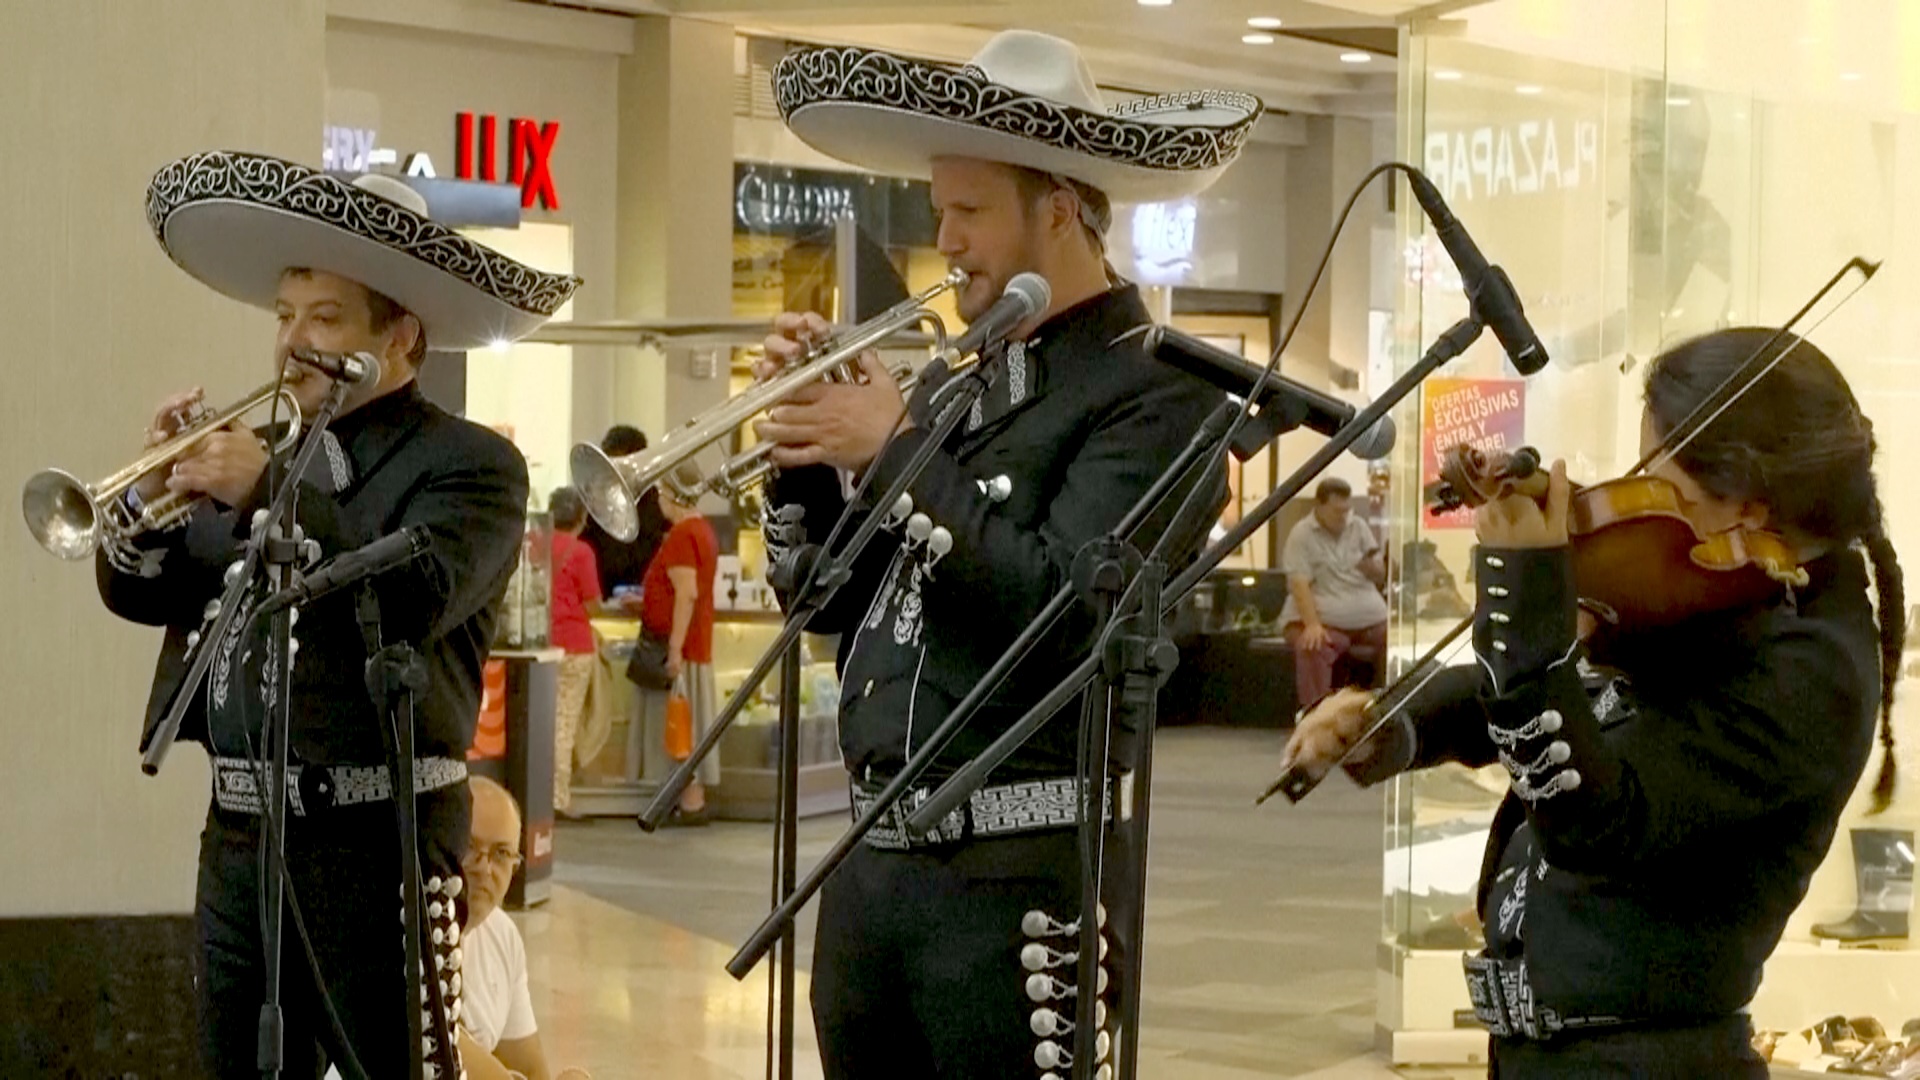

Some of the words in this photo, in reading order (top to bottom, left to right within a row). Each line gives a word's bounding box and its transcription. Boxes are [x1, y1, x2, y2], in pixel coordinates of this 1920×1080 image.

[1432, 385, 1481, 412] OFERTAS
[1434, 389, 1519, 431] EXCLUSIVAS
[1477, 419, 1486, 436] Y
